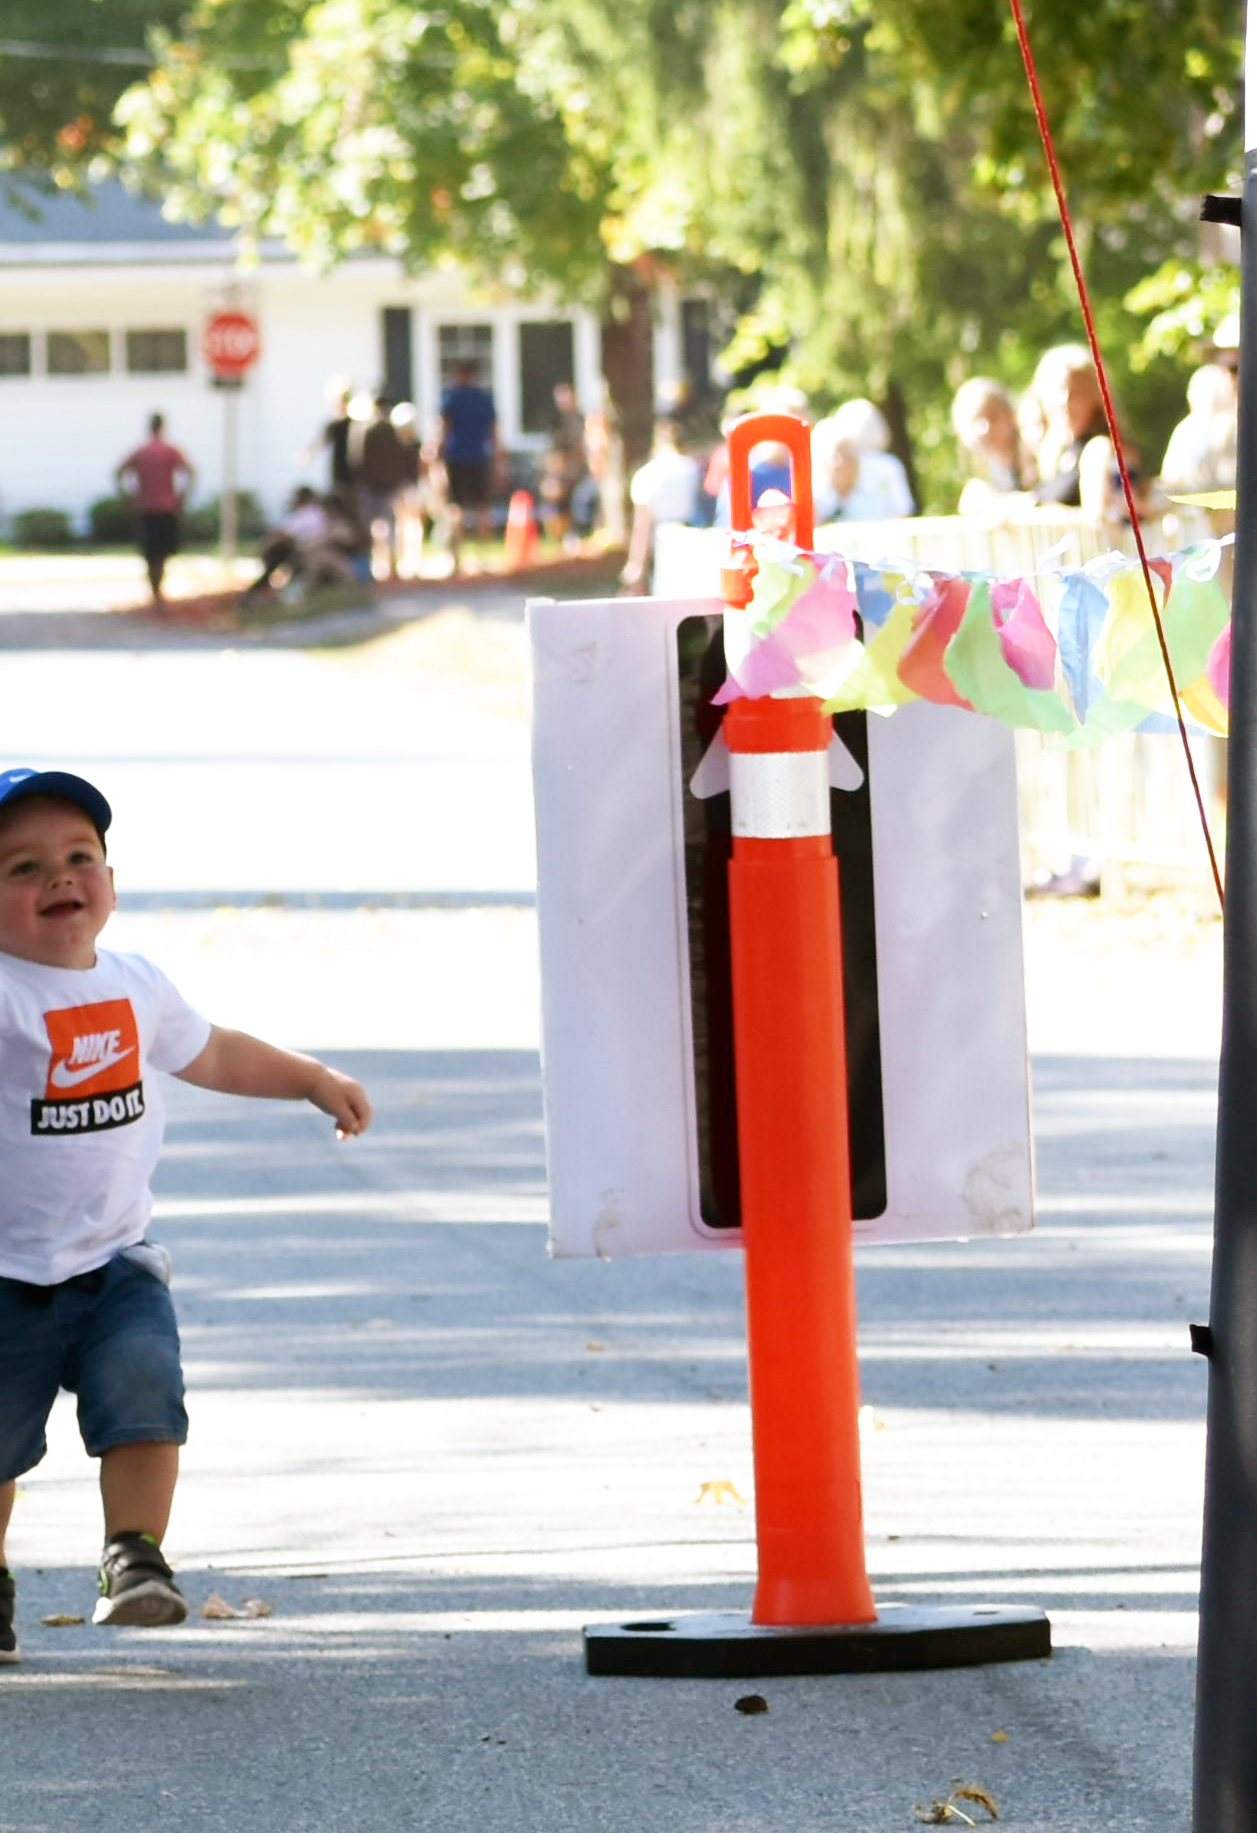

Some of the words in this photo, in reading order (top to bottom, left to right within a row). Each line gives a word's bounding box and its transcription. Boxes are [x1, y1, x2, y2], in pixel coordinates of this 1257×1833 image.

[208, 327, 257, 357] STOP
[67, 1029, 121, 1064] NIKE
[37, 1101, 90, 1129] JUST
[92, 1096, 125, 1124] DO
